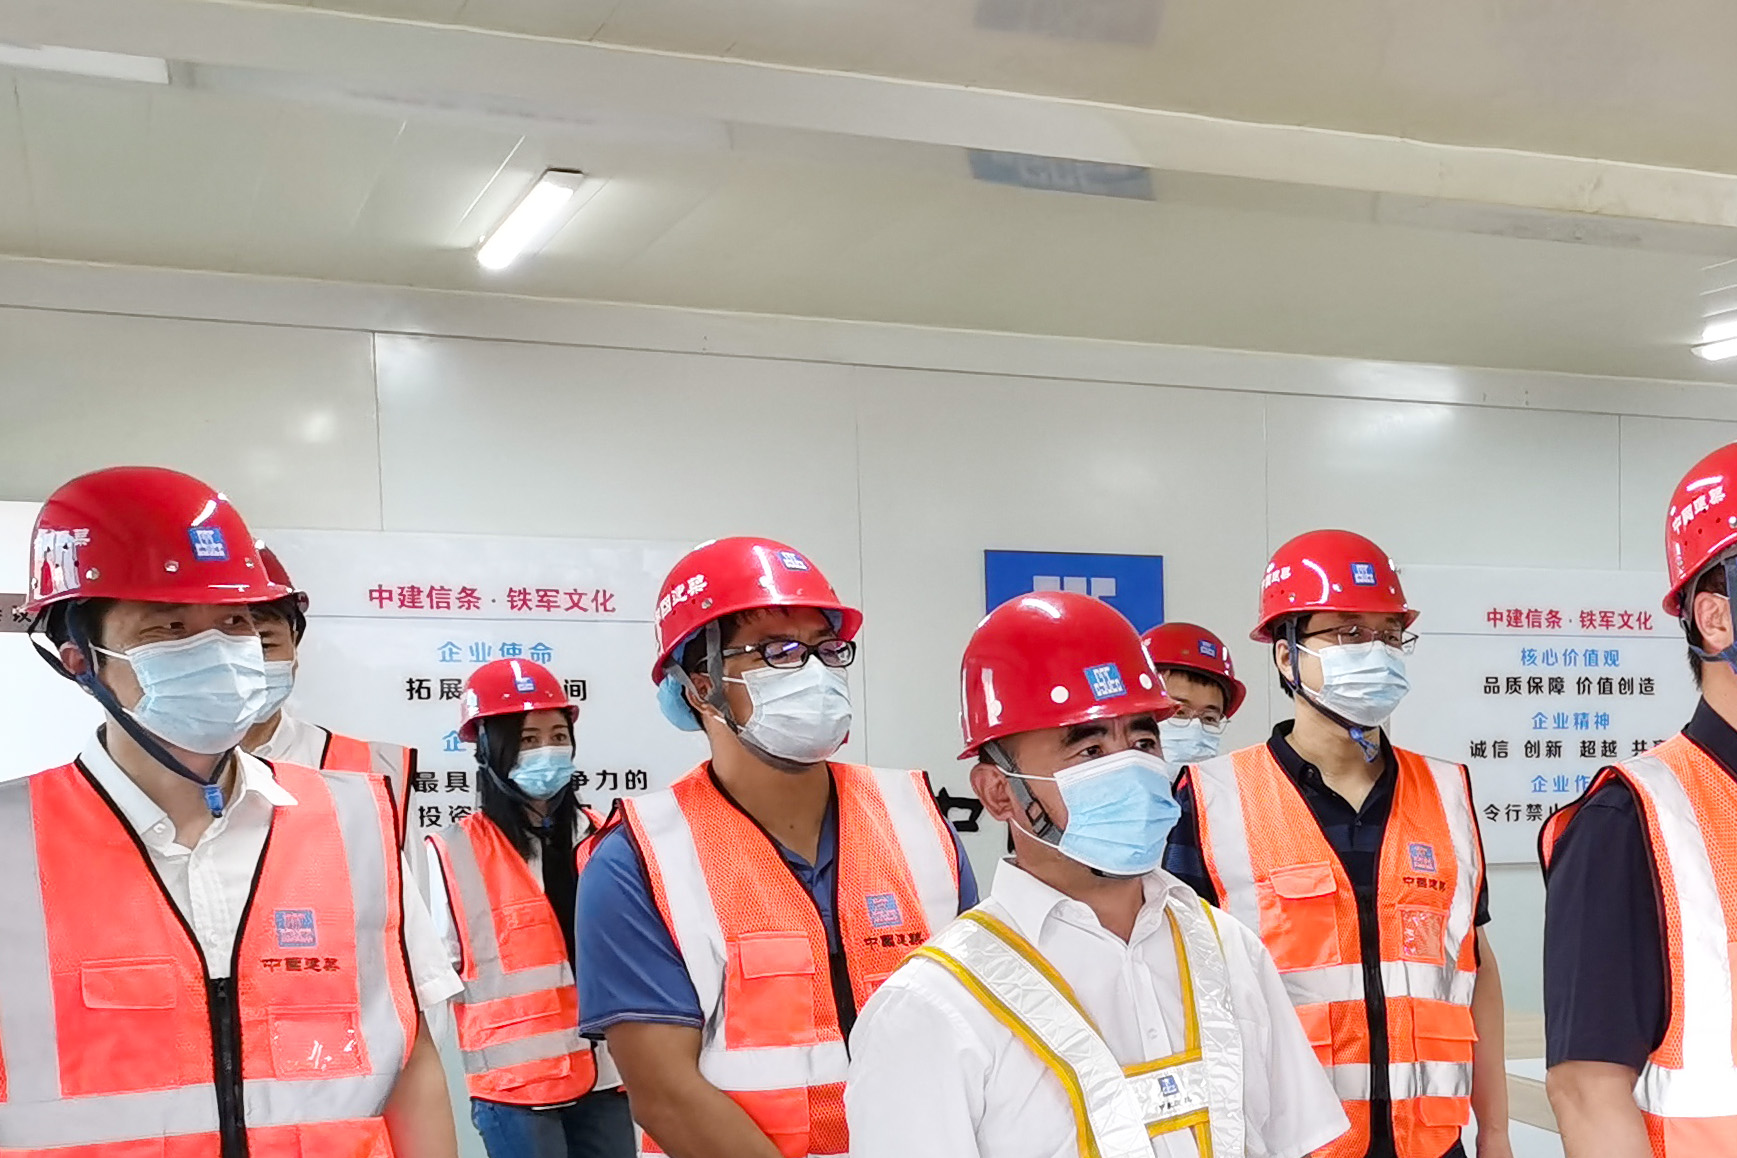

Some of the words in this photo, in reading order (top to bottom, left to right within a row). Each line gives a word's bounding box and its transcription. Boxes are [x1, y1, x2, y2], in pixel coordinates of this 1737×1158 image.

[368, 584, 616, 613] 中建信条·铁军文化
[1486, 608, 1653, 631] 中建信条·铁军文化
[437, 641, 554, 664] 企业使命
[1521, 648, 1620, 667] 核心价值观
[1483, 676, 1566, 695] 品质保障
[1576, 676, 1656, 696] 价值创造
[1531, 711, 1610, 731] 企业精神
[1469, 740, 1509, 759] 诚信
[1524, 740, 1563, 759] 创新
[1579, 739, 1618, 758] 超越
[1631, 739, 1667, 757] 共
